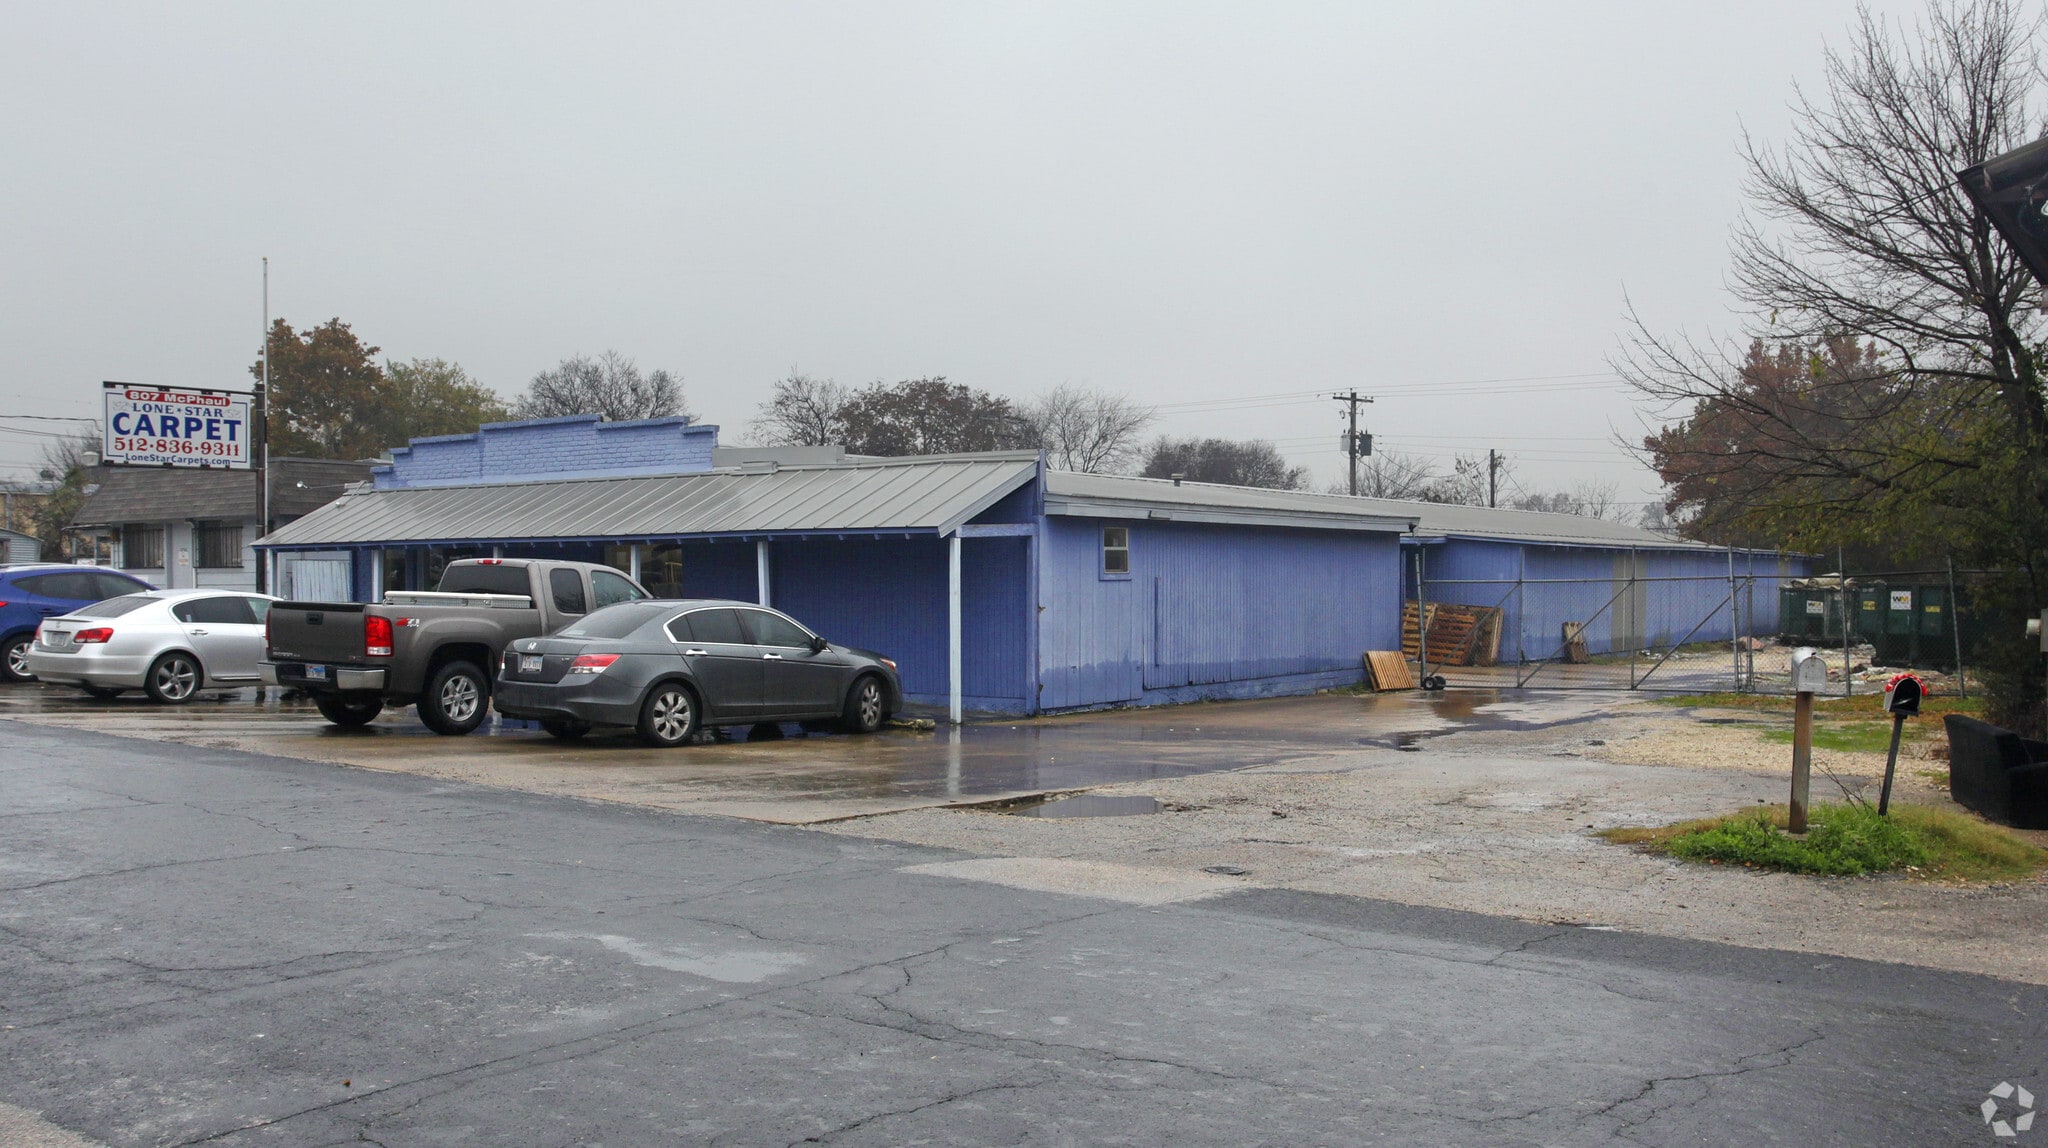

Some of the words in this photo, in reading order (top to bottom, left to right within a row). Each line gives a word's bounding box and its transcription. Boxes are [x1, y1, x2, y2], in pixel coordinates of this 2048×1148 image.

[129, 391, 160, 401] 807
[164, 392, 227, 406] McPhaul
[132, 402, 174, 415] LONE
[184, 406, 224, 418] STAR
[112, 412, 242, 441] CARPET
[125, 452, 231, 465] LoneStarCarpets.com
